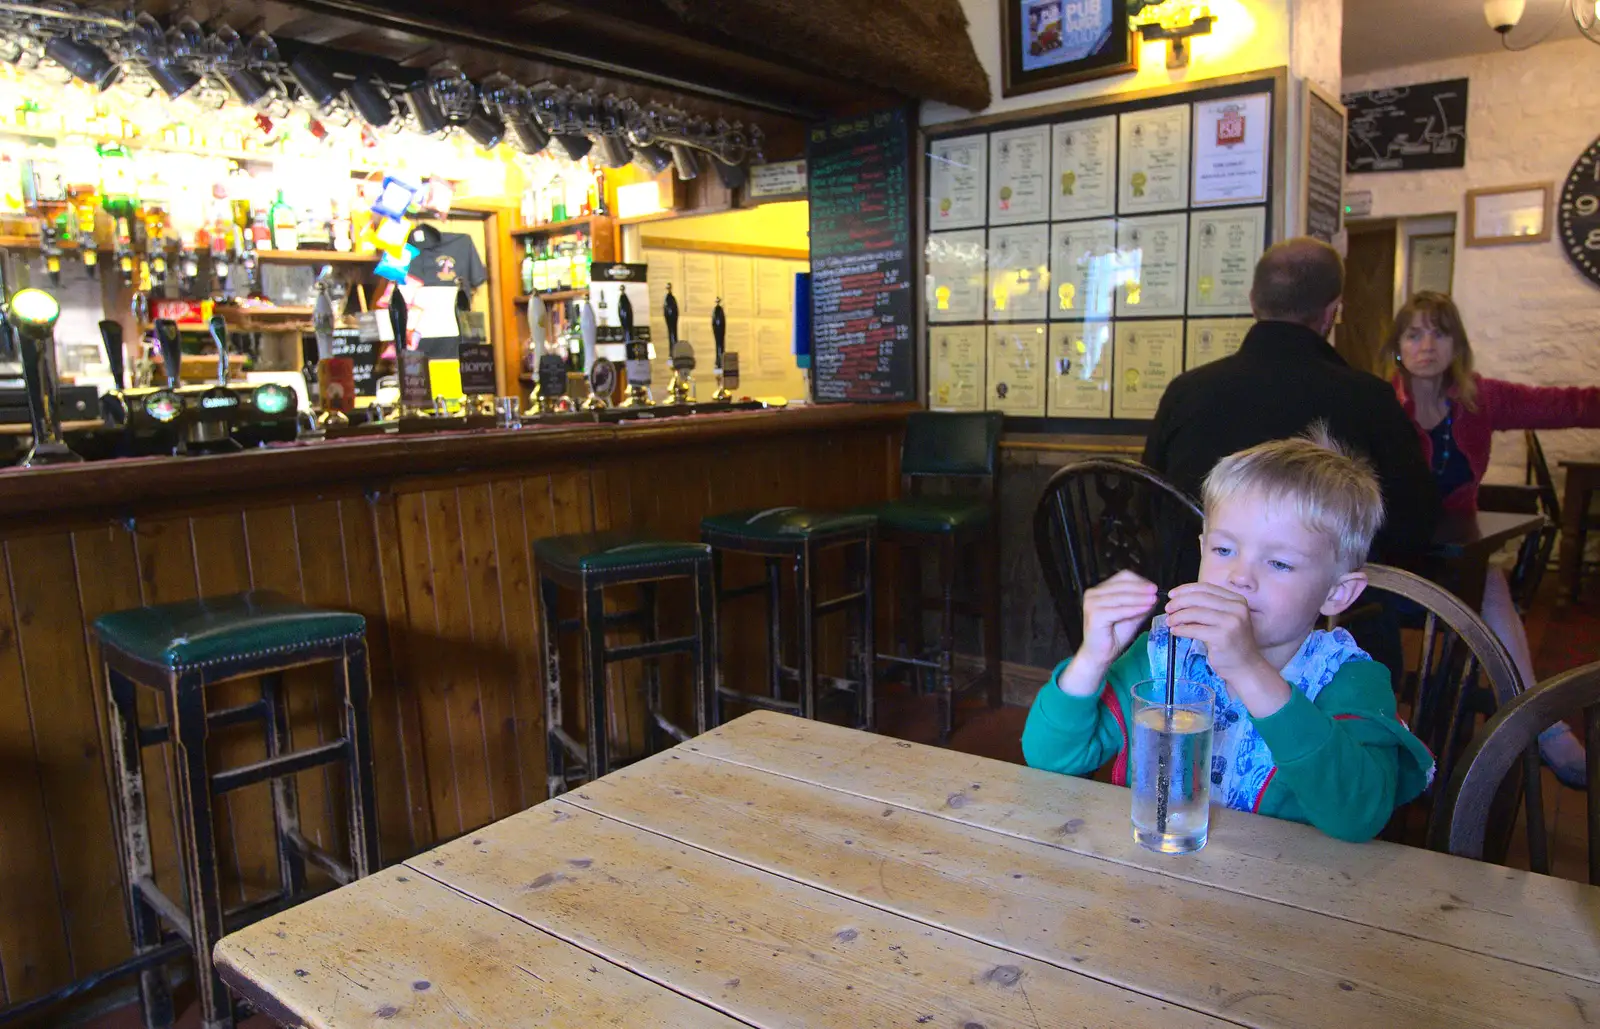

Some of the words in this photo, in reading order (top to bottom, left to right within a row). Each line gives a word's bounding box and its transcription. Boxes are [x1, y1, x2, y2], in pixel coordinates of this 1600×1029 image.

[1066, 0, 1101, 21] PUB
[1575, 194, 1599, 217] 9
[461, 362, 494, 373] HOPPY
